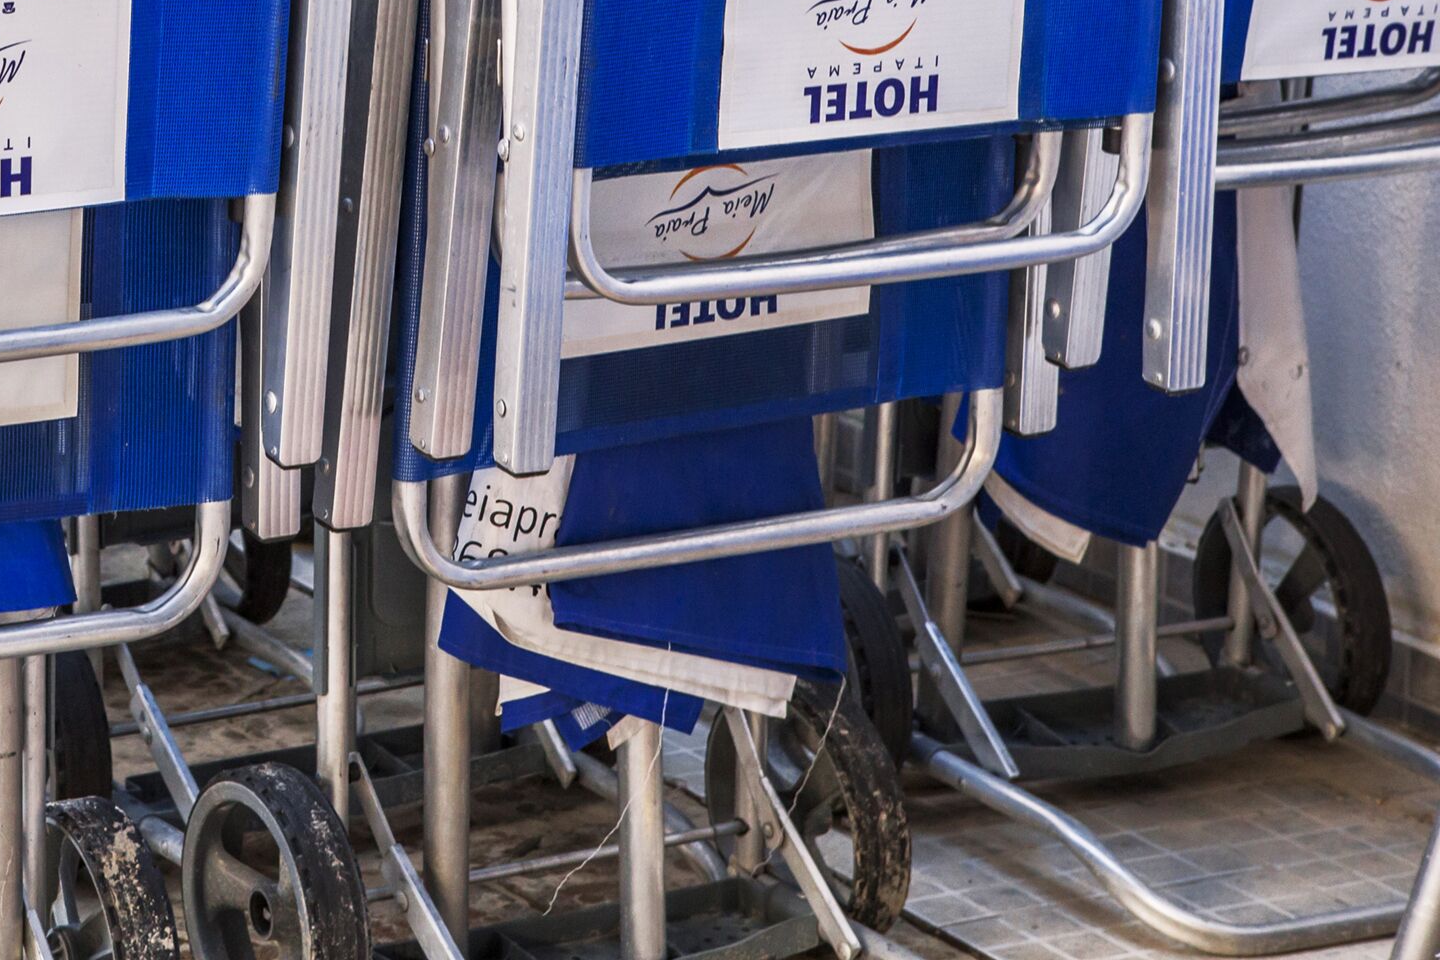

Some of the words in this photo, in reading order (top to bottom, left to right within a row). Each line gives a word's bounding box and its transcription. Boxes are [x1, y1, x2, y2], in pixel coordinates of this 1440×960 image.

[1328, 3, 1438, 21] ITAPEMA
[1321, 19, 1435, 60] HOTEL
[806, 55, 939, 79] ITAPEMA
[803, 74, 939, 125] HOTEL
[723, 183, 775, 219] Meia
[655, 206, 711, 242] Praia
[463, 485, 560, 542] eiapr
